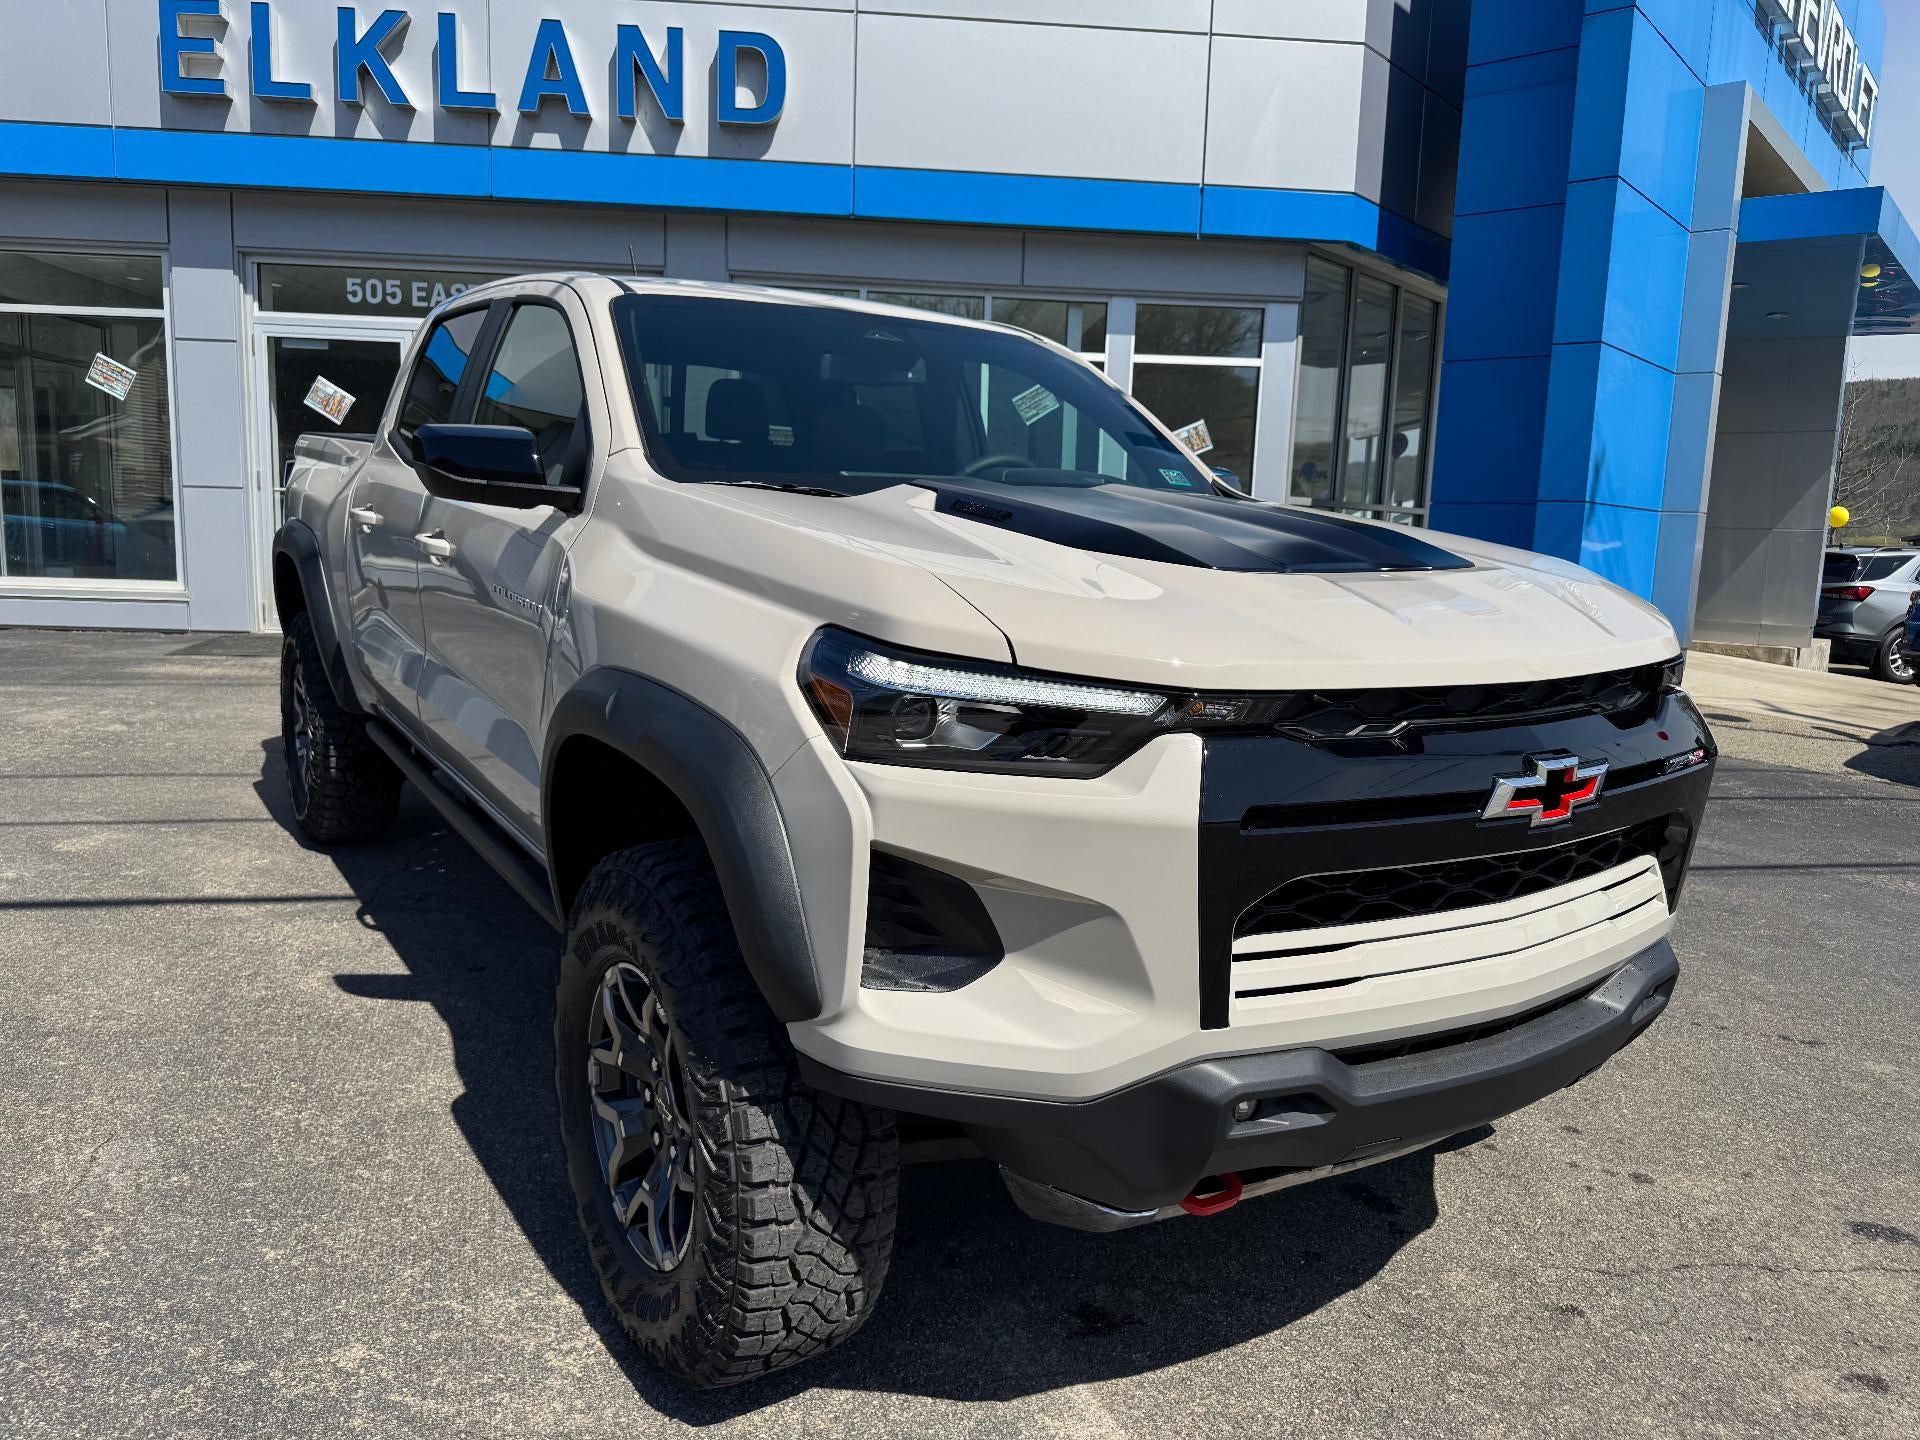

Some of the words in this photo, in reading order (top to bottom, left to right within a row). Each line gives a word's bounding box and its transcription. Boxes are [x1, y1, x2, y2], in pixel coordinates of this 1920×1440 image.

[160, 0, 787, 127] ELKLAND
[346, 277, 402, 305] 505
[411, 281, 482, 308] EAS
